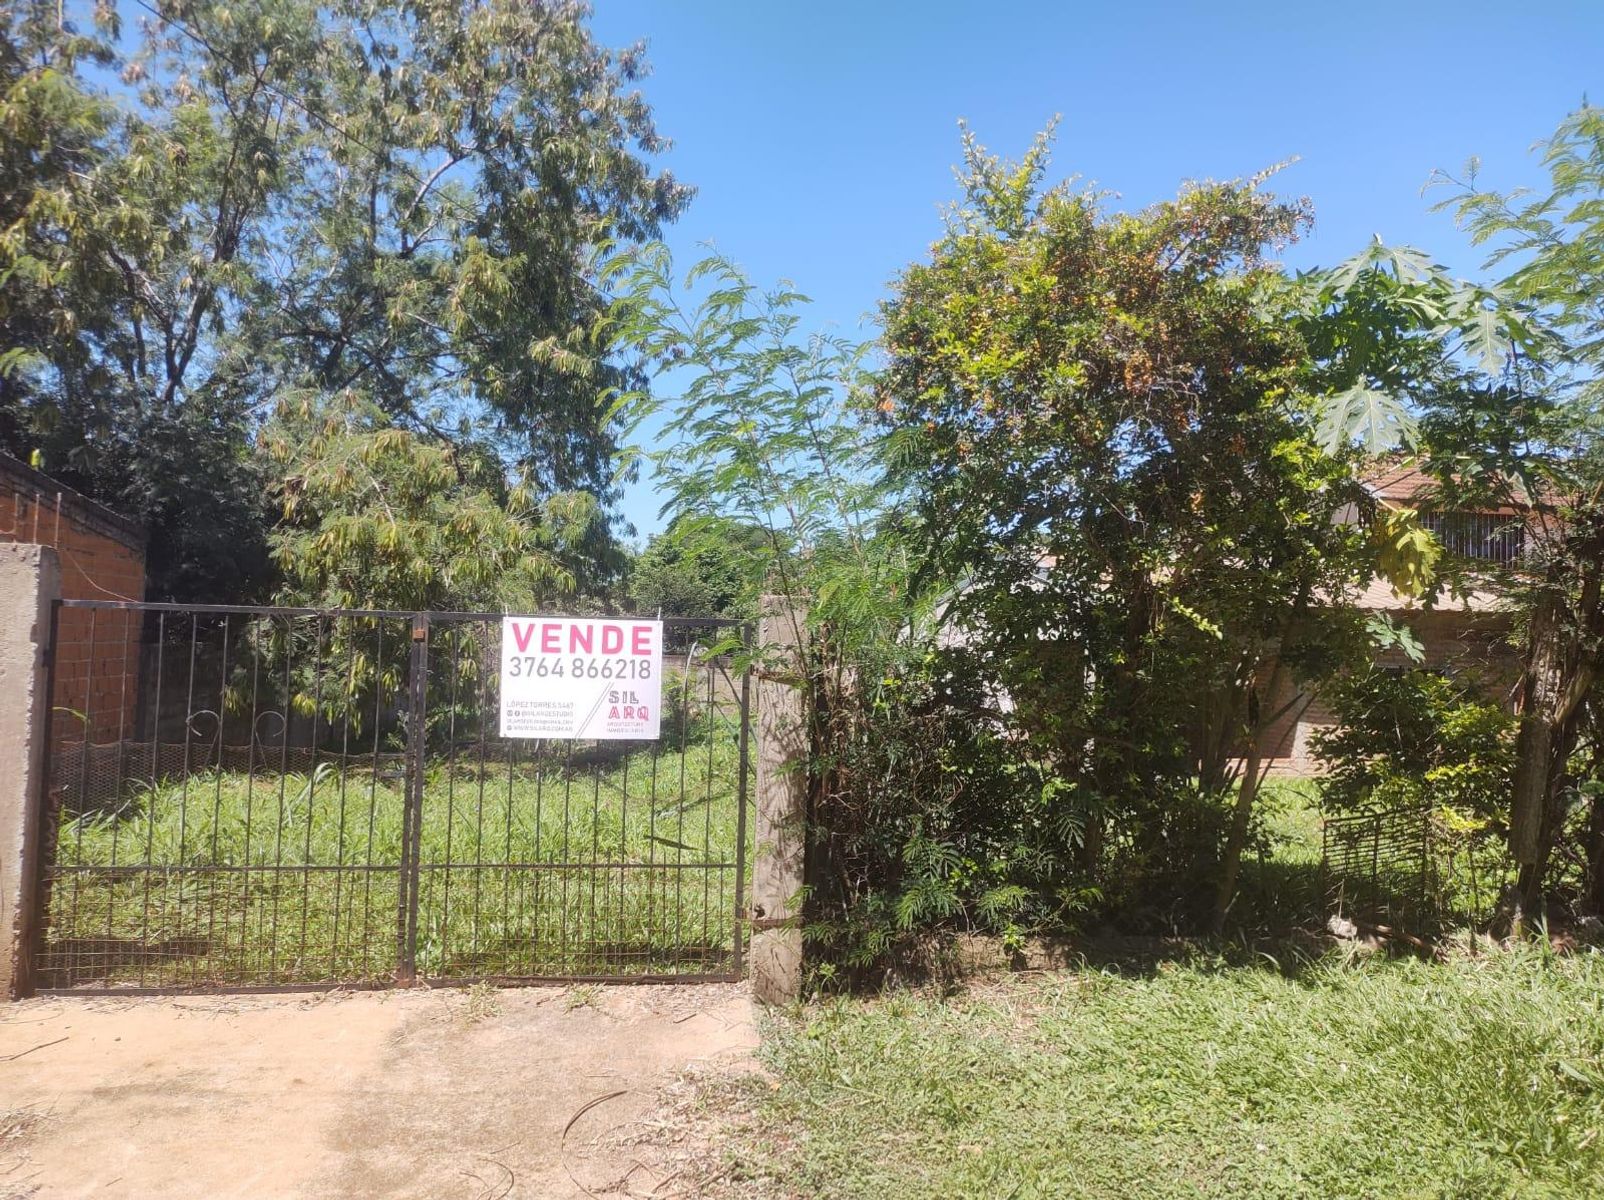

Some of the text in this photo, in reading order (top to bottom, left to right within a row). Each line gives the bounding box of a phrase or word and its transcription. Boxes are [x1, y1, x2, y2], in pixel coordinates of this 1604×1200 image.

[512, 622, 653, 656] VENDE
[509, 656, 651, 680] 3764 866218
[608, 690, 639, 704] SIL
[608, 705, 649, 721] ARQ
